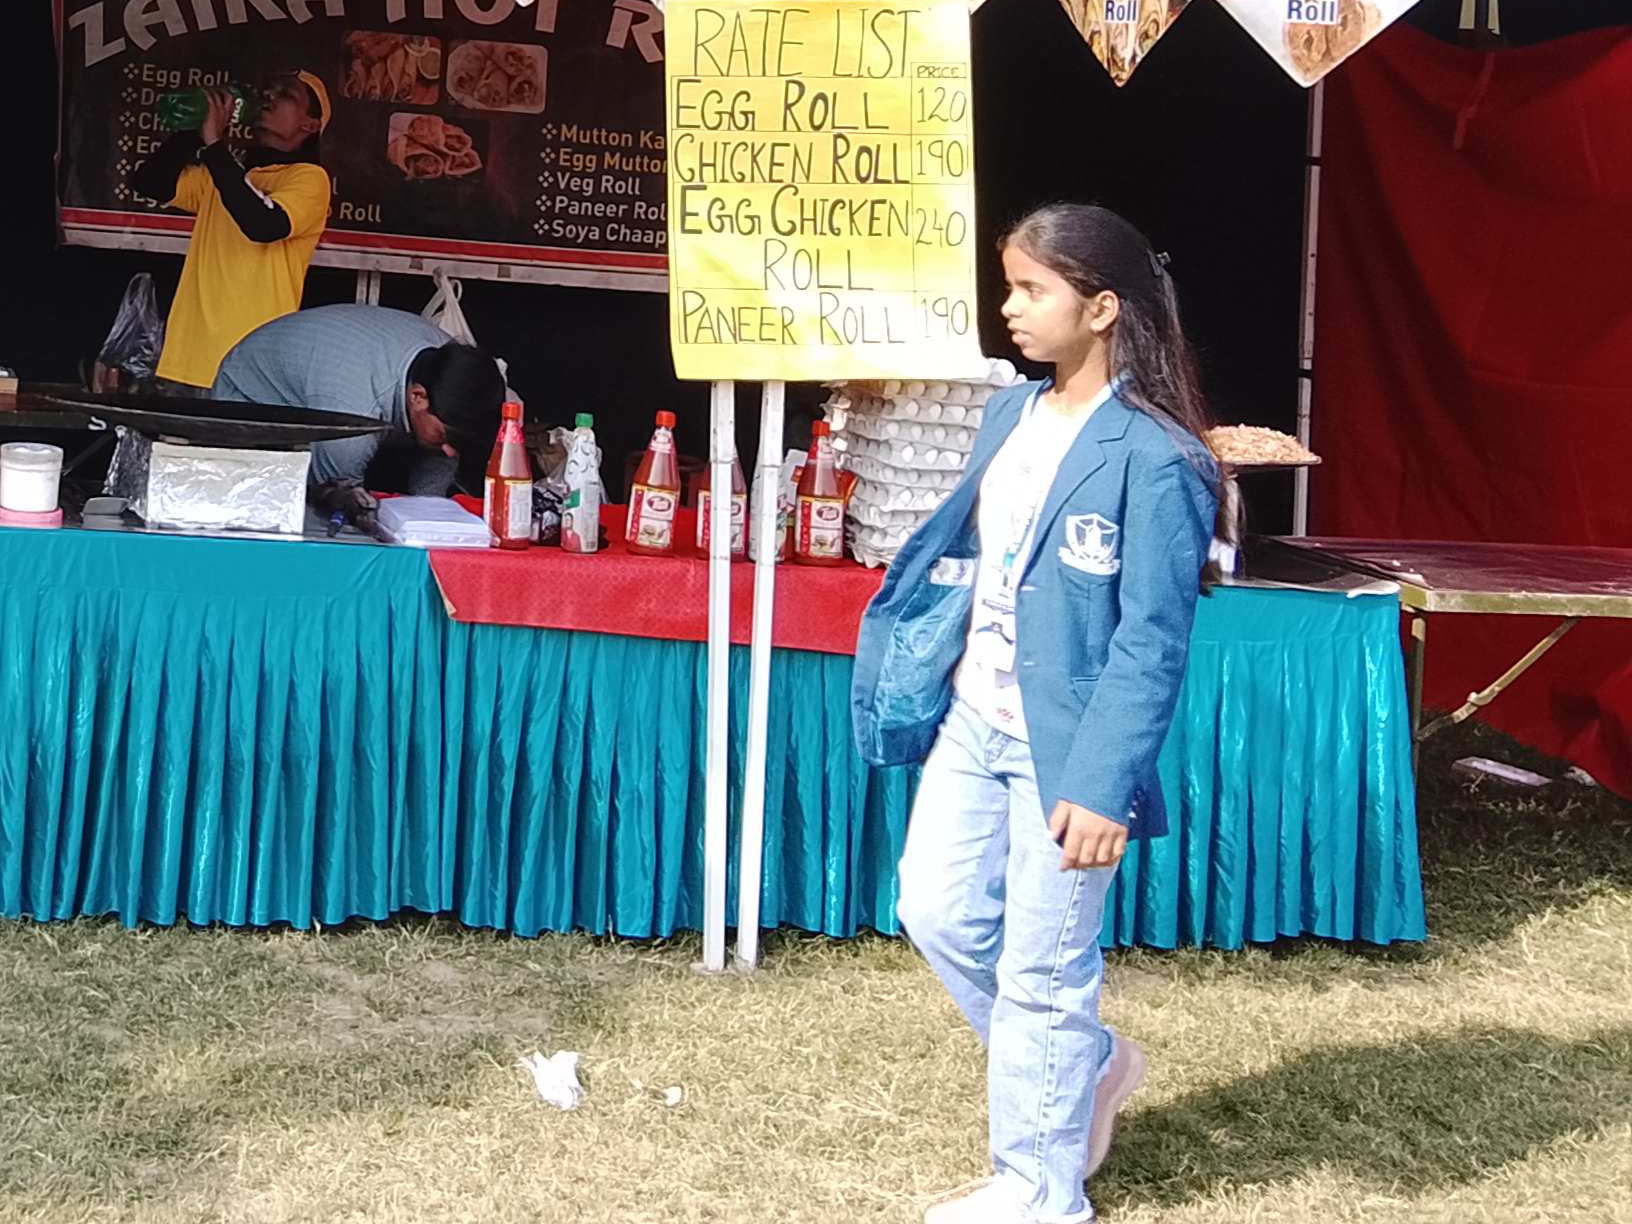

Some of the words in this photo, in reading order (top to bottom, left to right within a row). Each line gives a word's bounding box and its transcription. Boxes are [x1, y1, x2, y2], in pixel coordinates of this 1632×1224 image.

[1104, 0, 1137, 23] Roll
[1286, 0, 1338, 24] Roll
[694, 9, 809, 77] RATE
[832, 8, 920, 79] LIST
[142, 64, 181, 88] Egg
[916, 65, 959, 78] PRICE
[676, 79, 756, 131] EGG
[782, 79, 889, 132] ROLL
[917, 87, 966, 124] 120
[560, 124, 633, 148] Mutton
[559, 147, 597, 172] Egg
[674, 134, 813, 183] CHICKEN
[832, 133, 910, 184] ROLL
[916, 140, 963, 177] 190
[556, 171, 593, 196] Veg
[600, 175, 641, 196] Roll
[339, 202, 382, 223] Roll
[554, 195, 629, 217] Paneer
[680, 185, 761, 236] EGG
[771, 185, 909, 237] CHICKEN
[551, 219, 600, 243] Soya
[606, 223, 667, 249] Chaap
[915, 209, 966, 248] 240
[764, 239, 874, 290] ROLL
[682, 290, 797, 345] PANEER
[819, 291, 905, 345] ROLL
[921, 297, 968, 338] 190
